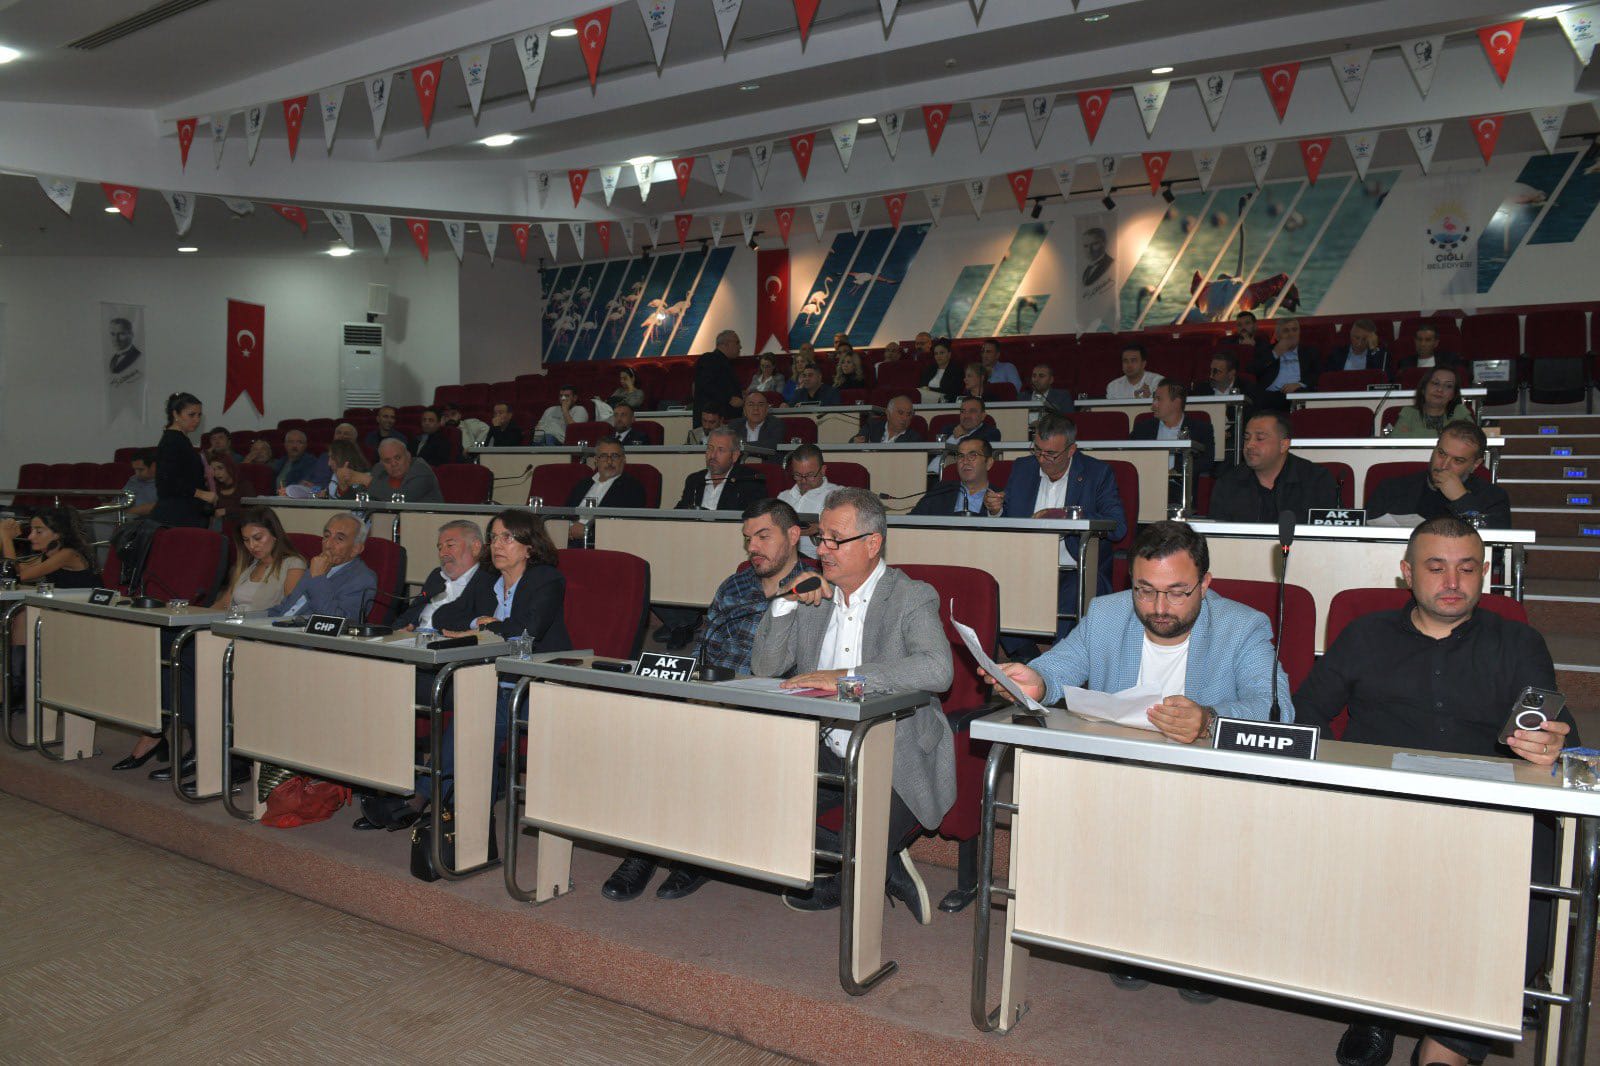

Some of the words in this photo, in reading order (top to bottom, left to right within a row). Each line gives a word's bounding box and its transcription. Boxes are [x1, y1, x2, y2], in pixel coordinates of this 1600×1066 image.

[1326, 510, 1349, 519] AK
[314, 621, 336, 632] CHP
[655, 657, 679, 669] AK
[640, 667, 687, 682] PARTİ
[1235, 732, 1294, 750] MHP
